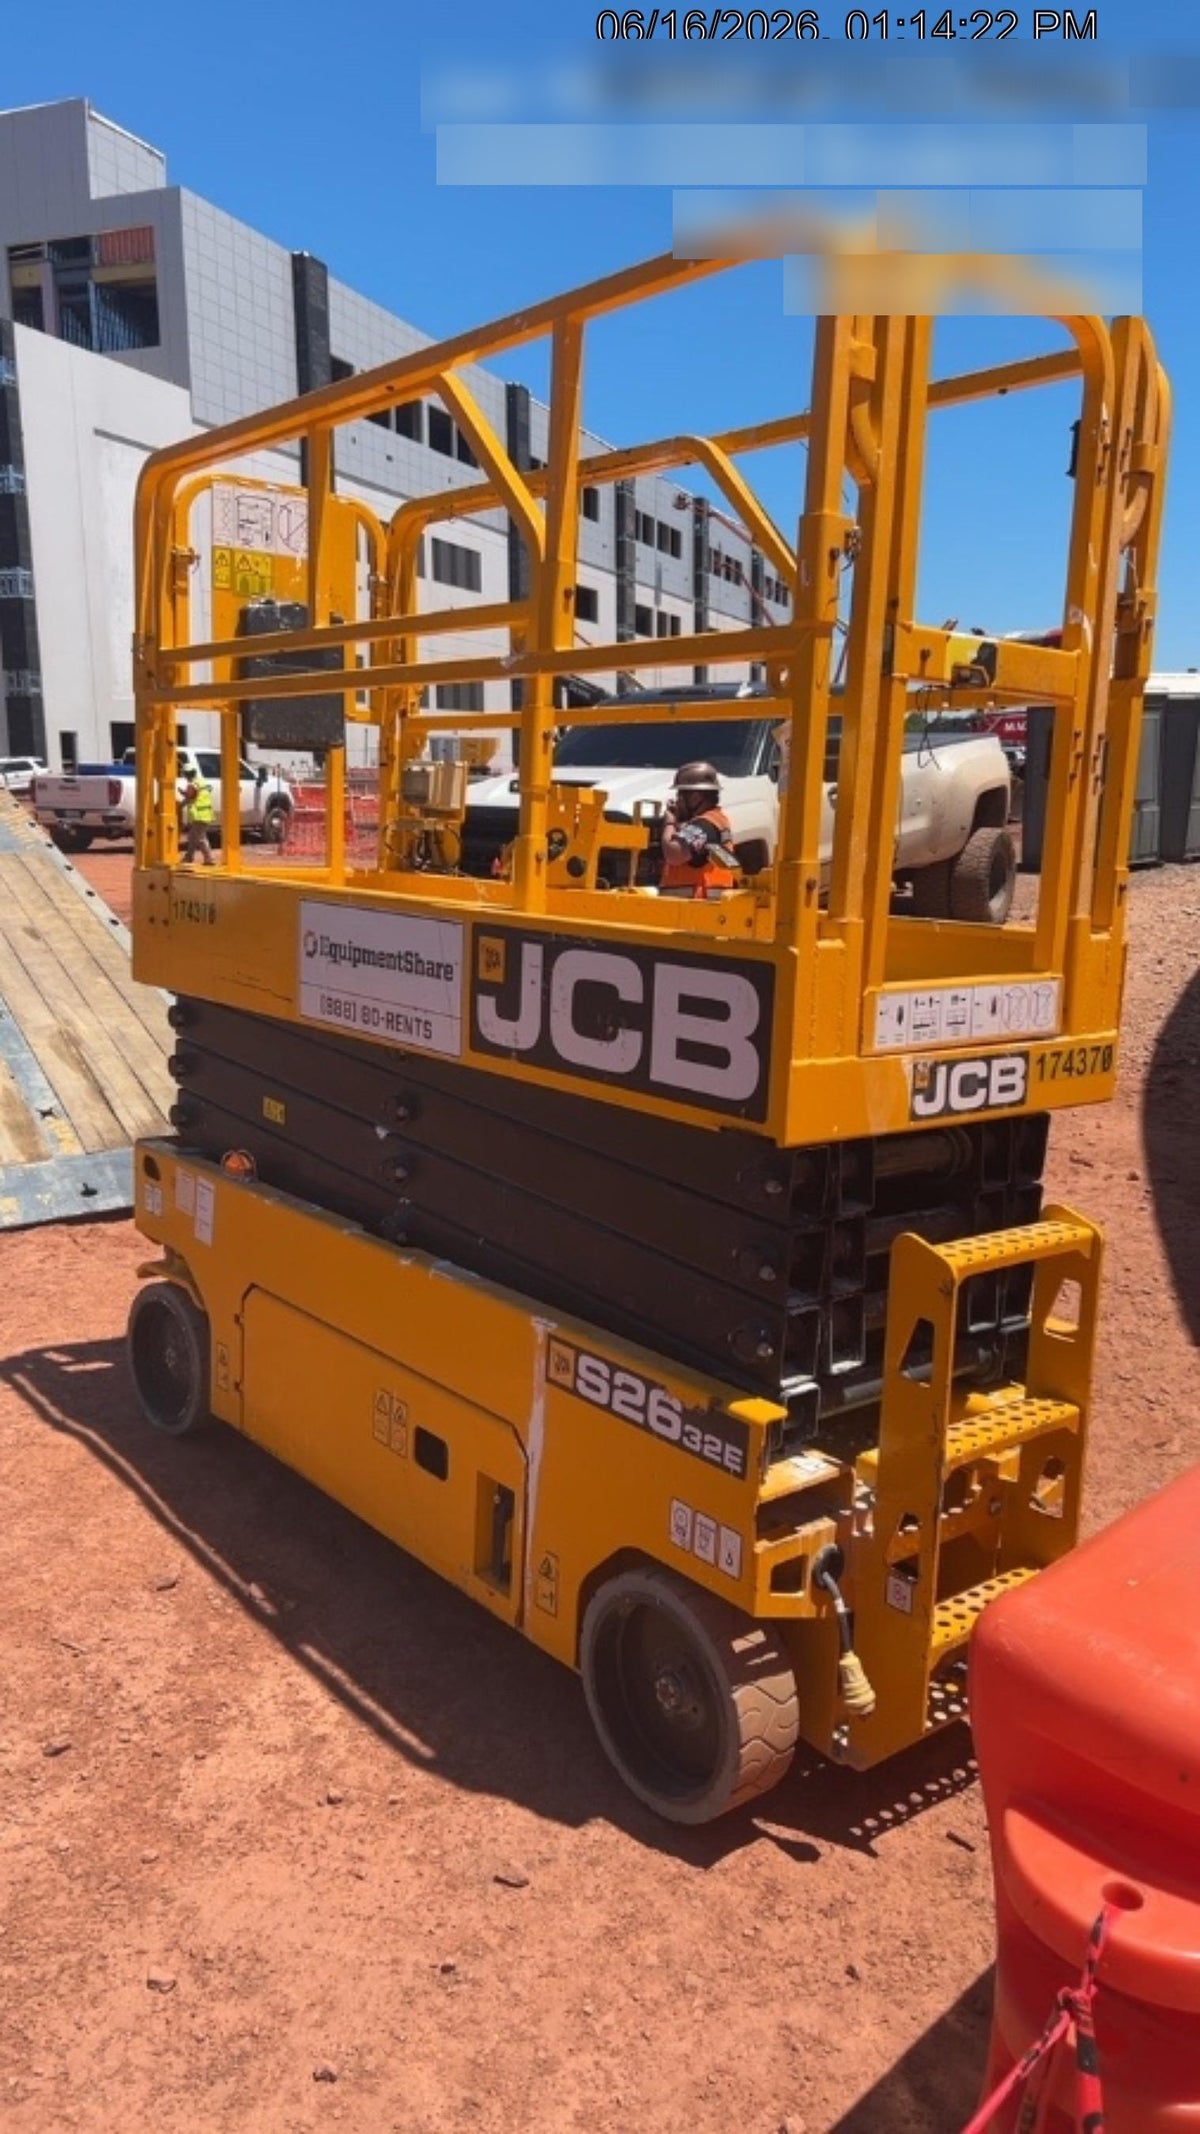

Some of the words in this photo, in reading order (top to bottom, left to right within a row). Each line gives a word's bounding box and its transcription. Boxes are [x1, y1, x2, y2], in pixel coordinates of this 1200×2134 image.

[320, 935, 454, 981] EquipmentShare
[477, 942, 760, 1101] JCB
[913, 1056, 1025, 1116] JCB
[1036, 1045, 1113, 1083] 174370
